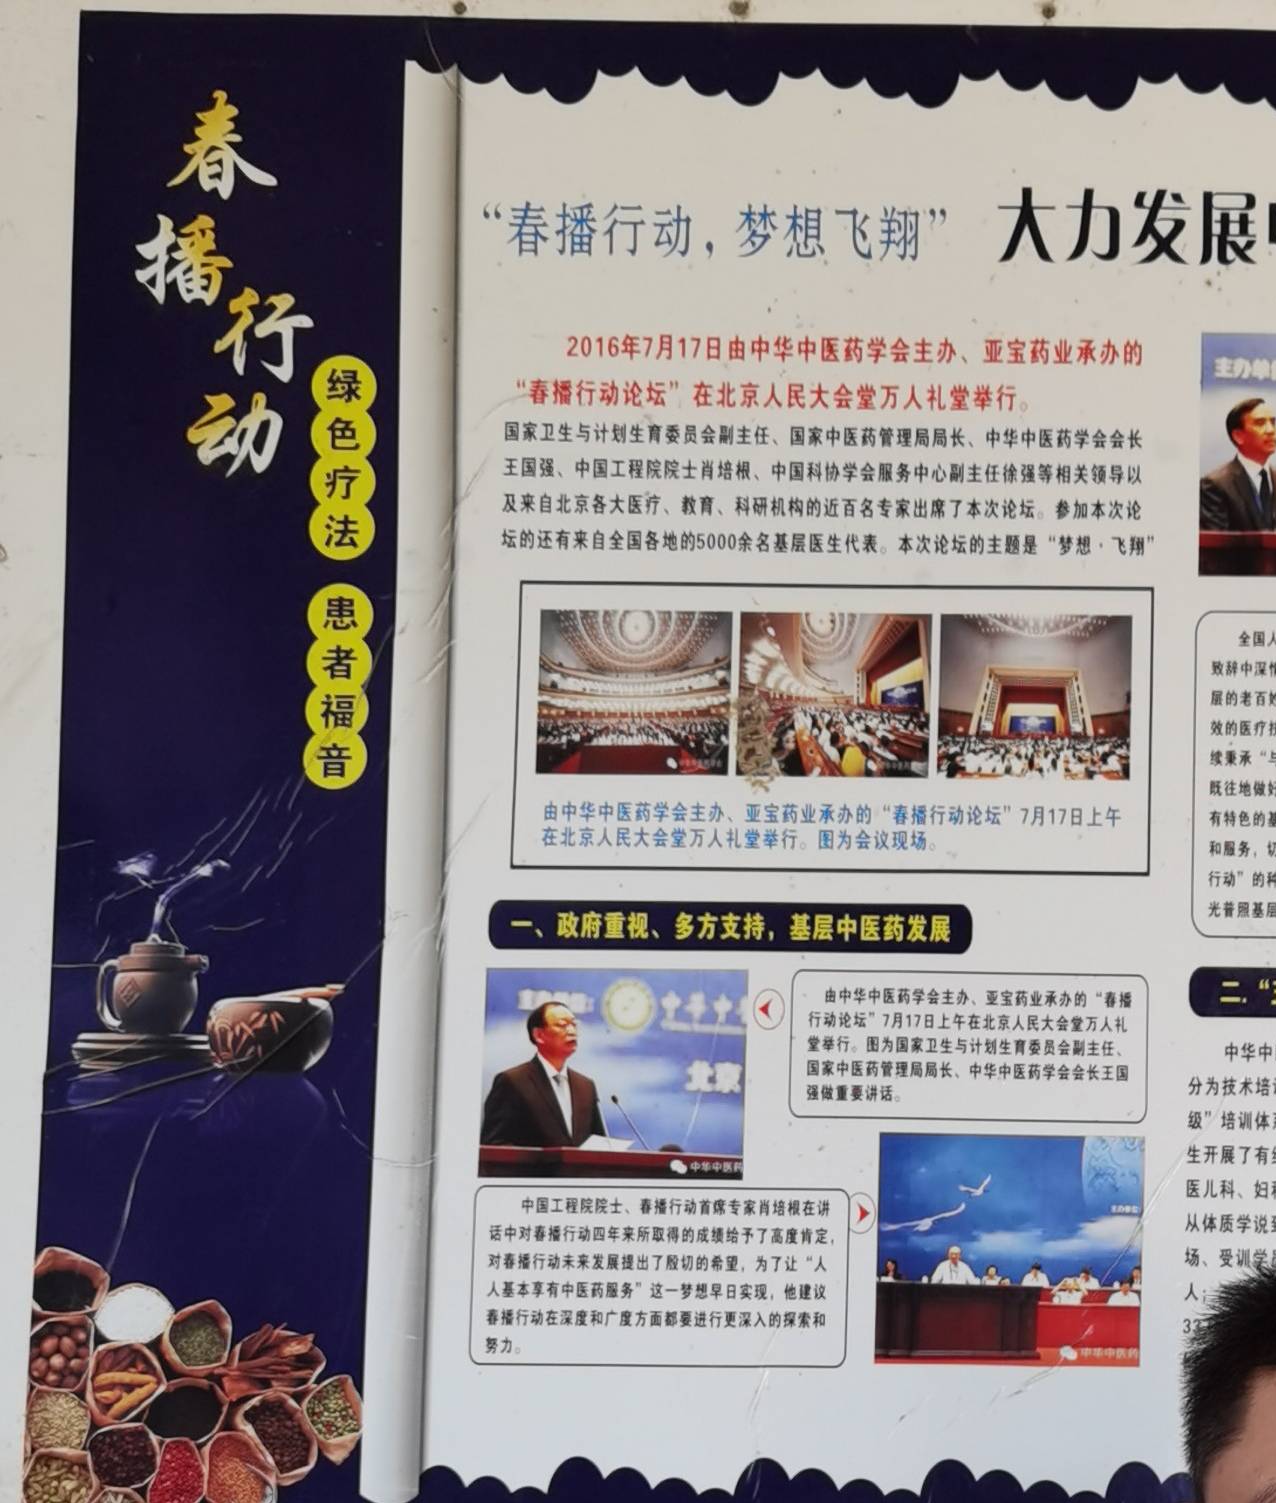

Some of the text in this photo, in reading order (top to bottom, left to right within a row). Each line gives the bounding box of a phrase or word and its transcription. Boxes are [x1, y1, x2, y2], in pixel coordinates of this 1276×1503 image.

[483, 200, 947, 261] “春播行动，梦想飞翔”
[566, 334, 1143, 366] 2016年7月17日由中华中医药学会主办、亚宝药业承办的
[504, 422, 1142, 449] 国家卫生与计划生育委员会副主任、国家中医药管理局局长、中华中医药学会会长
[324, 368, 361, 549] 绿色疗法
[503, 458, 1141, 485] 王国强、中国工程院院士肖培根、中国科协学会服务中心副主任徐强等相关领导以
[502, 493, 1141, 520] 及来自北京各大医疗、教育、科研机构的近百名专家出席了本次论坛。参加本次论
[318, 595, 358, 779] 患者福音
[542, 826, 935, 851] 在北京人民大会堂万人礼堂举行。图为会议现场。
[510, 911, 952, 944] 一、政府重视、多方支持，基层中医药发展
[806, 1060, 1129, 1082] 国家中医药管理局局长、中华中医药学会会长王国
[806, 1084, 901, 1103] 强做重要讲话。
[486, 1309, 826, 1329] 春播行动在深度和广度方面都要进行更深入的探索和
[485, 1337, 521, 1355] 努力。
